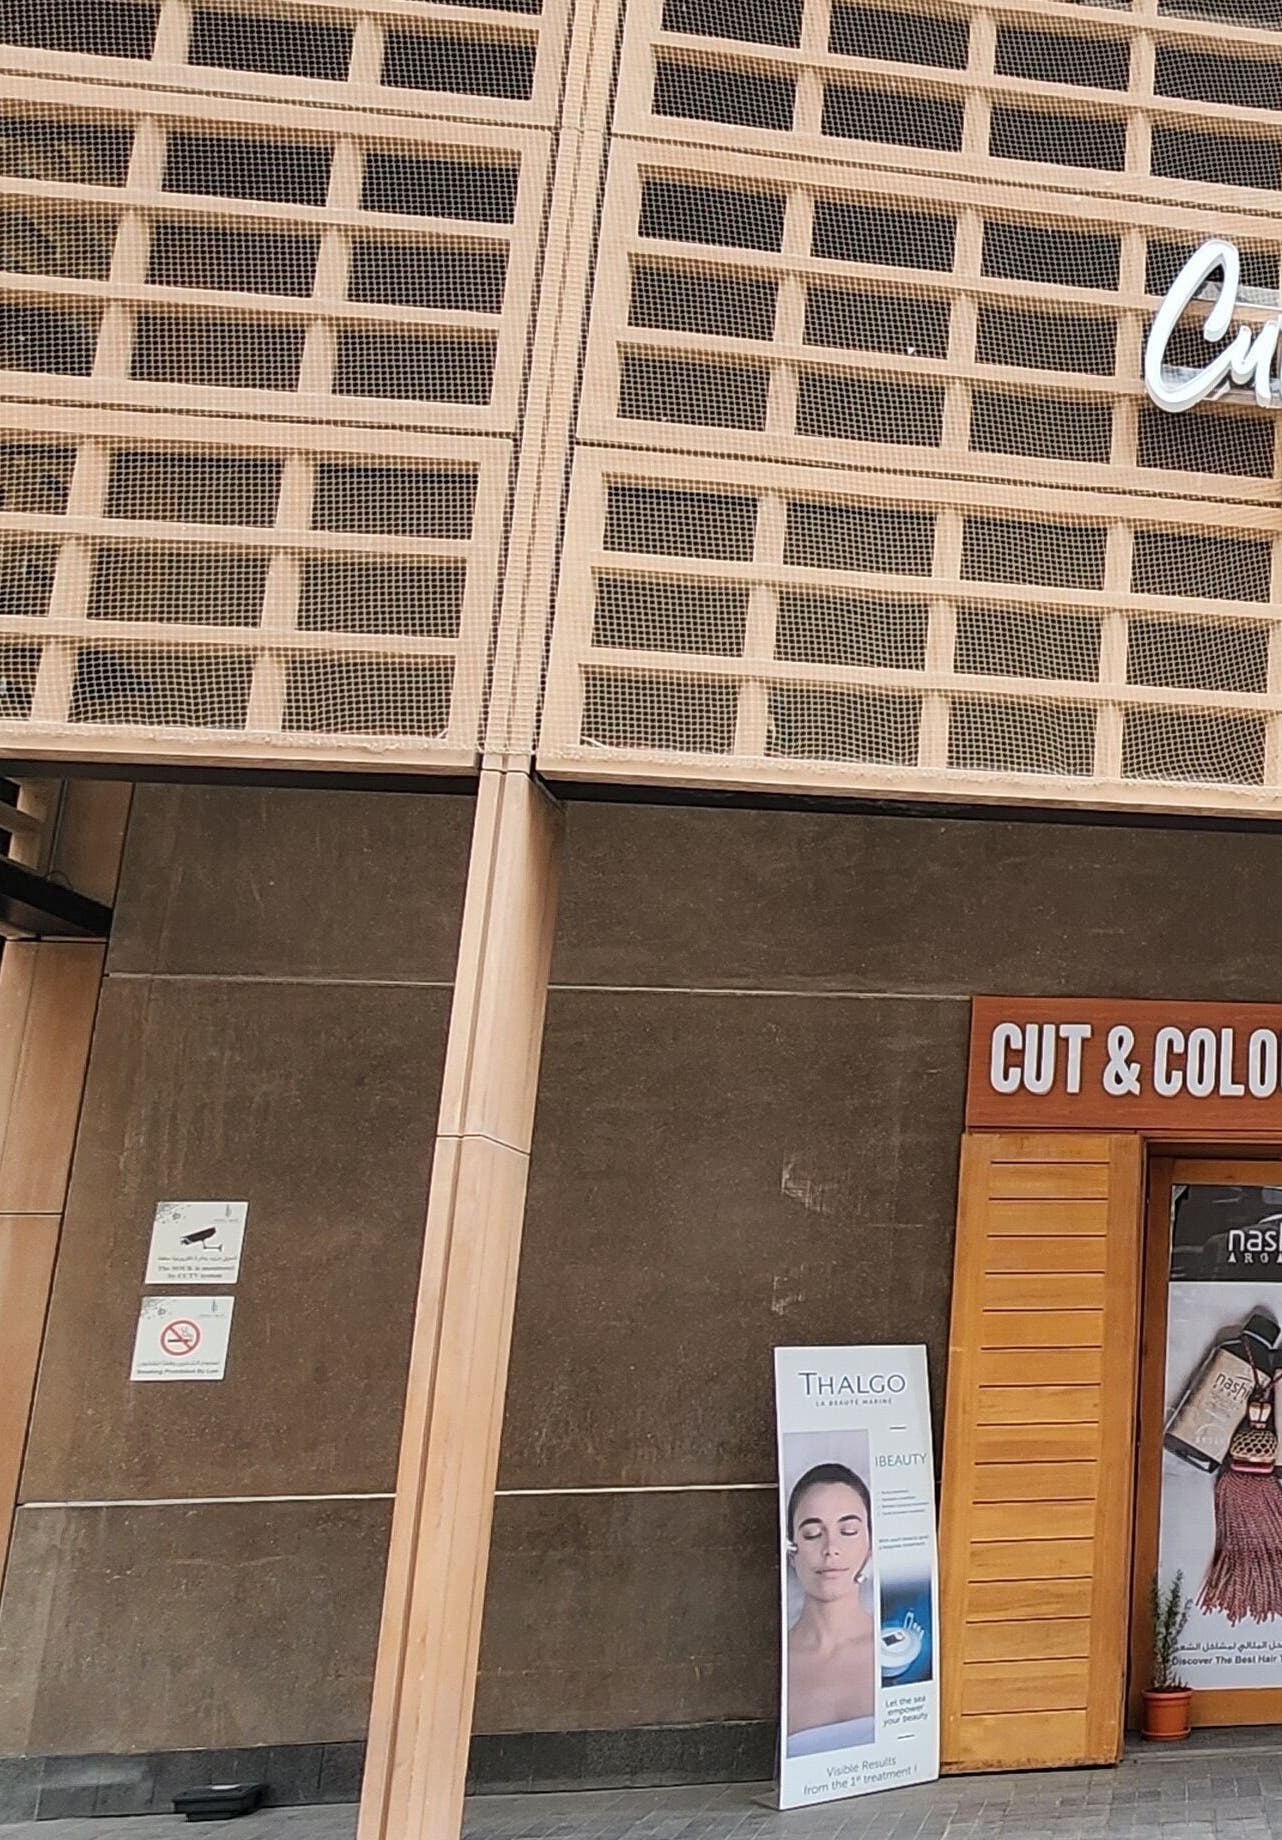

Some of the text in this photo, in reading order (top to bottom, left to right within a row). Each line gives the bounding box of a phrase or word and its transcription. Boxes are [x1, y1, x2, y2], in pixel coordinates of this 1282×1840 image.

[990, 1022, 1092, 1094] CUT
[1102, 1025, 1142, 1096] &
[797, 1371, 906, 1396] THALGO
[1215, 1372, 1253, 1400] nashi
[1215, 1656, 1233, 1665] The
[1258, 1654, 1277, 1663] Hair
[885, 1699, 897, 1708] Let
[899, 1696, 912, 1705] the
[887, 1704, 923, 1716] empower
[883, 1712, 928, 1727] your beauty
[826, 1756, 896, 1777] Visible Results
[803, 1783, 829, 1795] from
[831, 1779, 848, 1790] the
[863, 1766, 912, 1783] treatment
